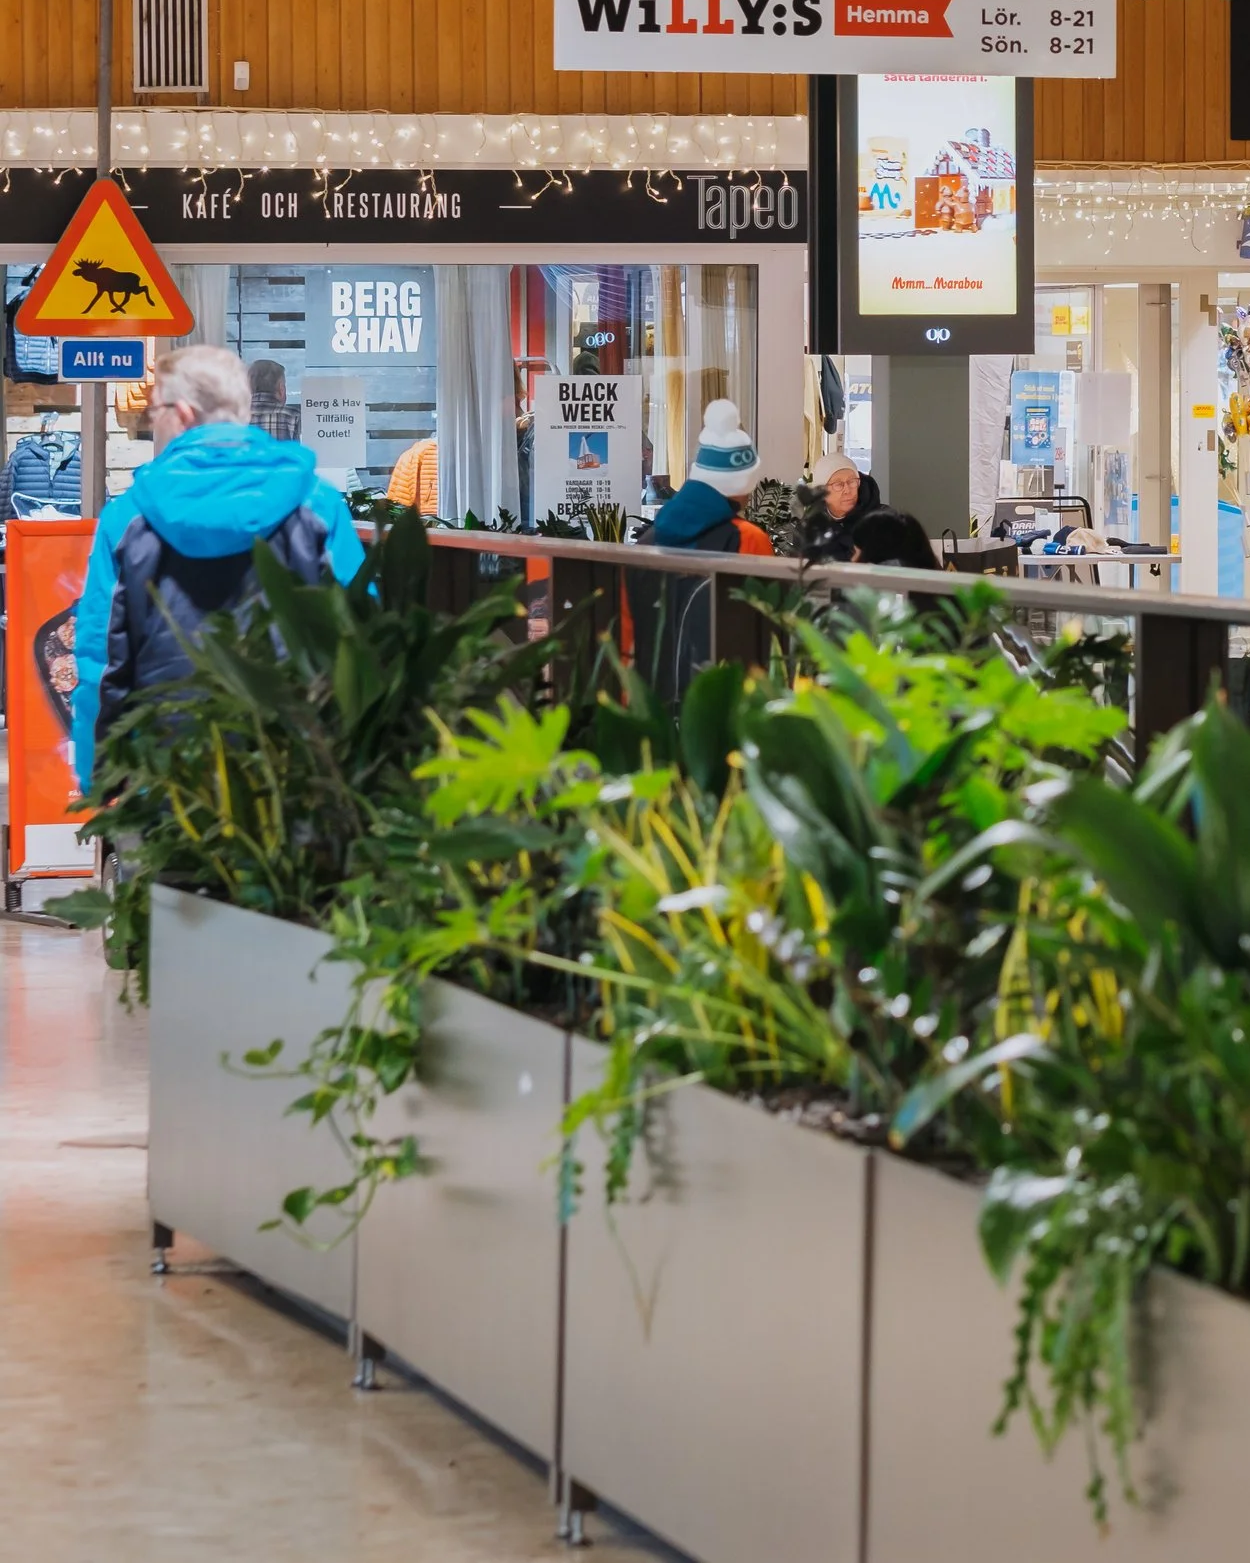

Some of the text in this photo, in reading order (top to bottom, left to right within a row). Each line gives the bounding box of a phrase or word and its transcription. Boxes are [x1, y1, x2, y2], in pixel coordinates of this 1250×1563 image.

[846, 5, 929, 24] Hemma
[981, 8, 1094, 27] Lör. 8-21
[980, 35, 1094, 54] Sön. 8-21
[182, 188, 462, 219] KAFÉ OCH RESTAURANG
[686, 175, 799, 240] Tapeo
[331, 281, 421, 317] BERG
[73, 351, 132, 366] Allt nu
[558, 382, 618, 402] BLACK
[305, 398, 361, 410] Berg & Hav
[561, 403, 615, 422] WEEK
[316, 414, 355, 424] Tillfällig
[317, 429, 351, 438] Outlet!
